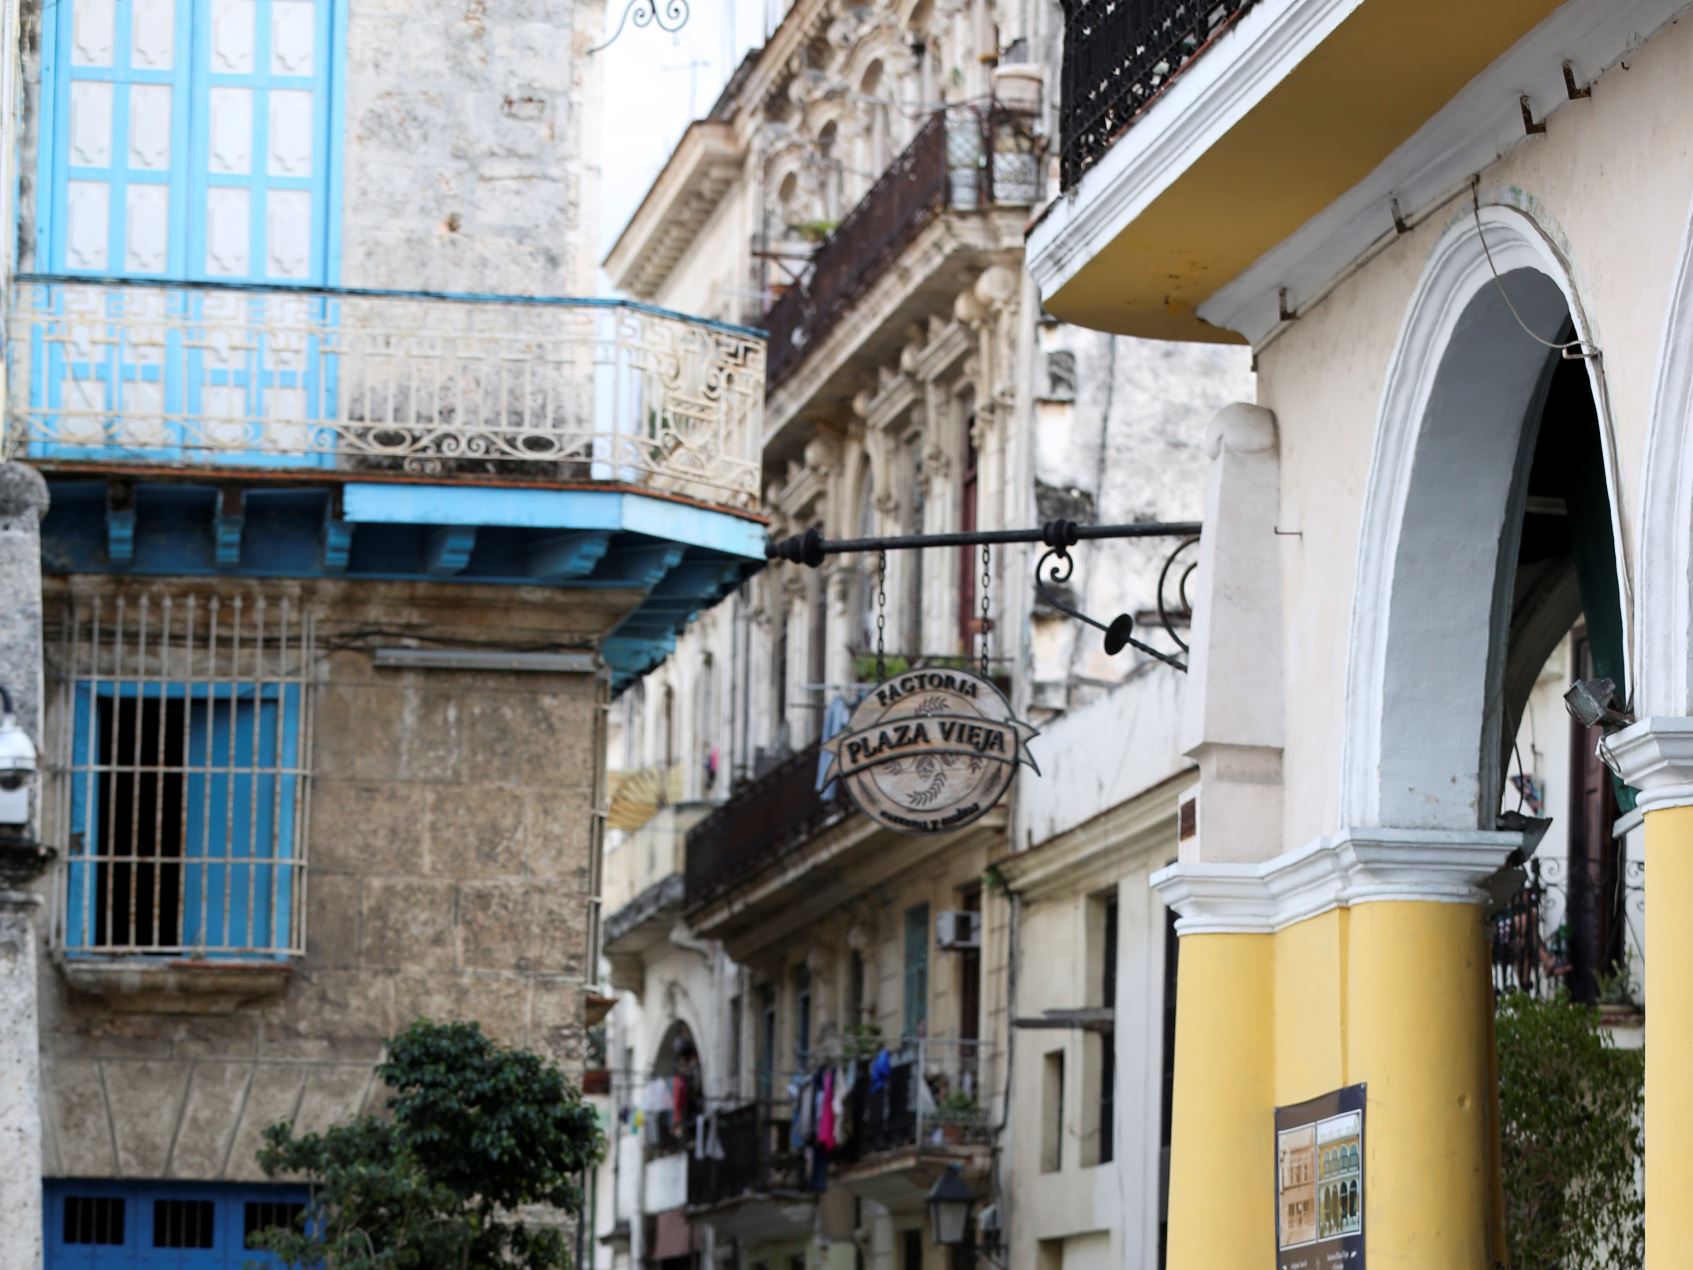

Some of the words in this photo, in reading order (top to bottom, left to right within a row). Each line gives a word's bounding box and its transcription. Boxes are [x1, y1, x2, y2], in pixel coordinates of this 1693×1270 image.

[875, 673, 978, 707] FACTORIA
[846, 721, 930, 764] PLAZA
[937, 720, 1006, 754] VIEJA
